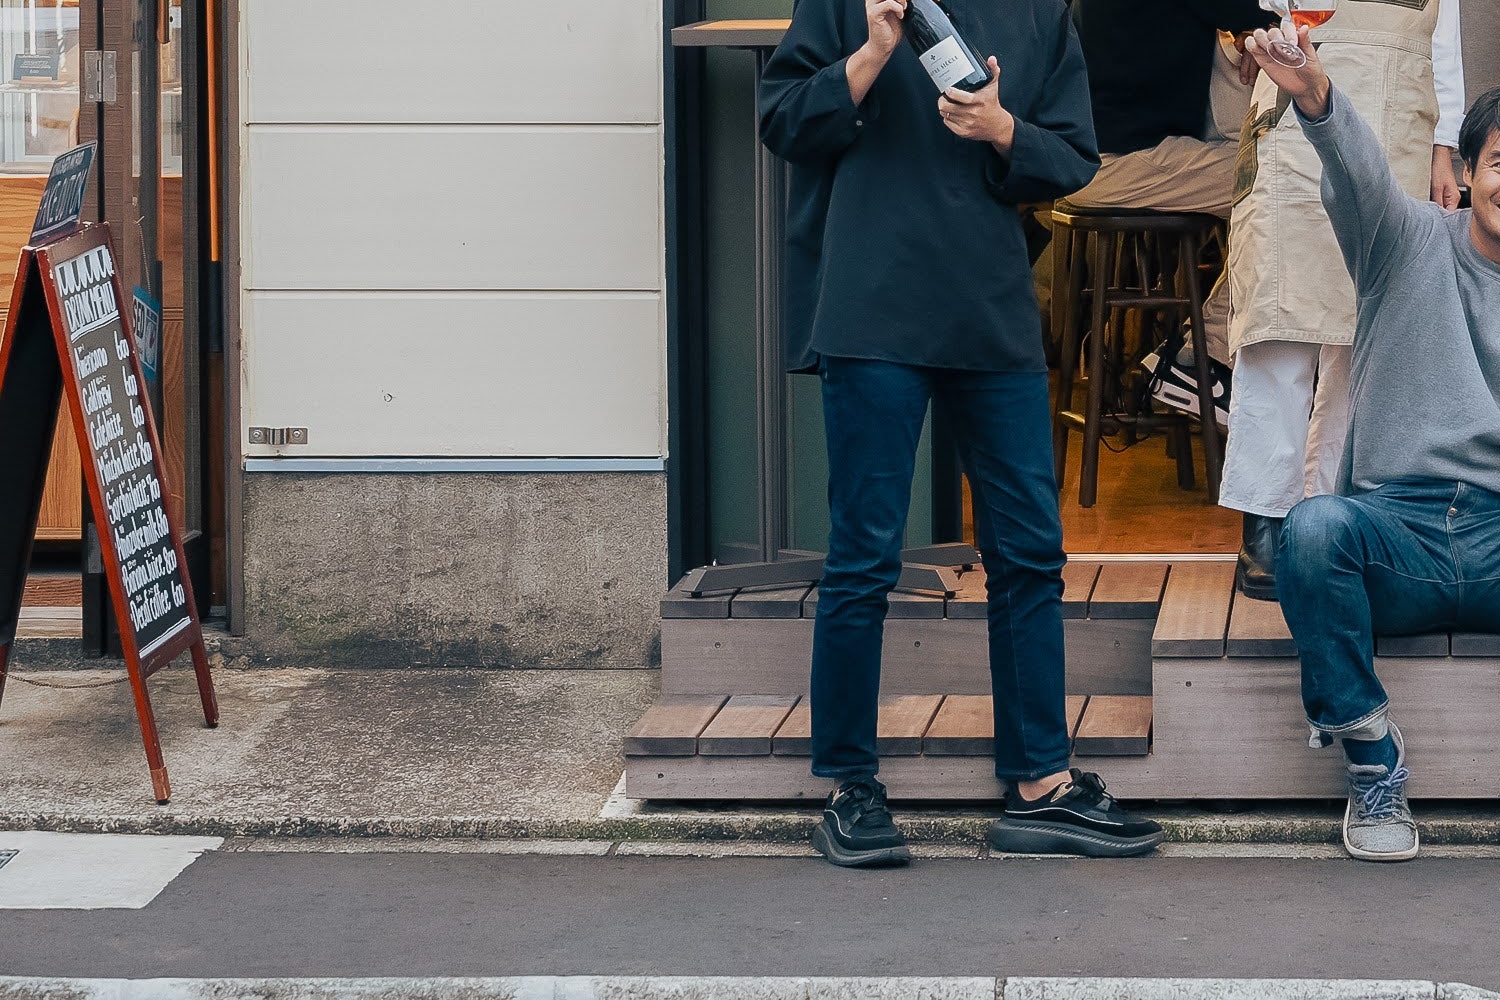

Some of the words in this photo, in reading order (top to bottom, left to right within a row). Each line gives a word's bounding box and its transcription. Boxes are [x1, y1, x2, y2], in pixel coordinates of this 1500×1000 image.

[114, 331, 130, 360] 600
[122, 366, 138, 396] 600
[129, 399, 145, 428] 600
[136, 431, 153, 465] 800
[171, 580, 185, 607] 600
